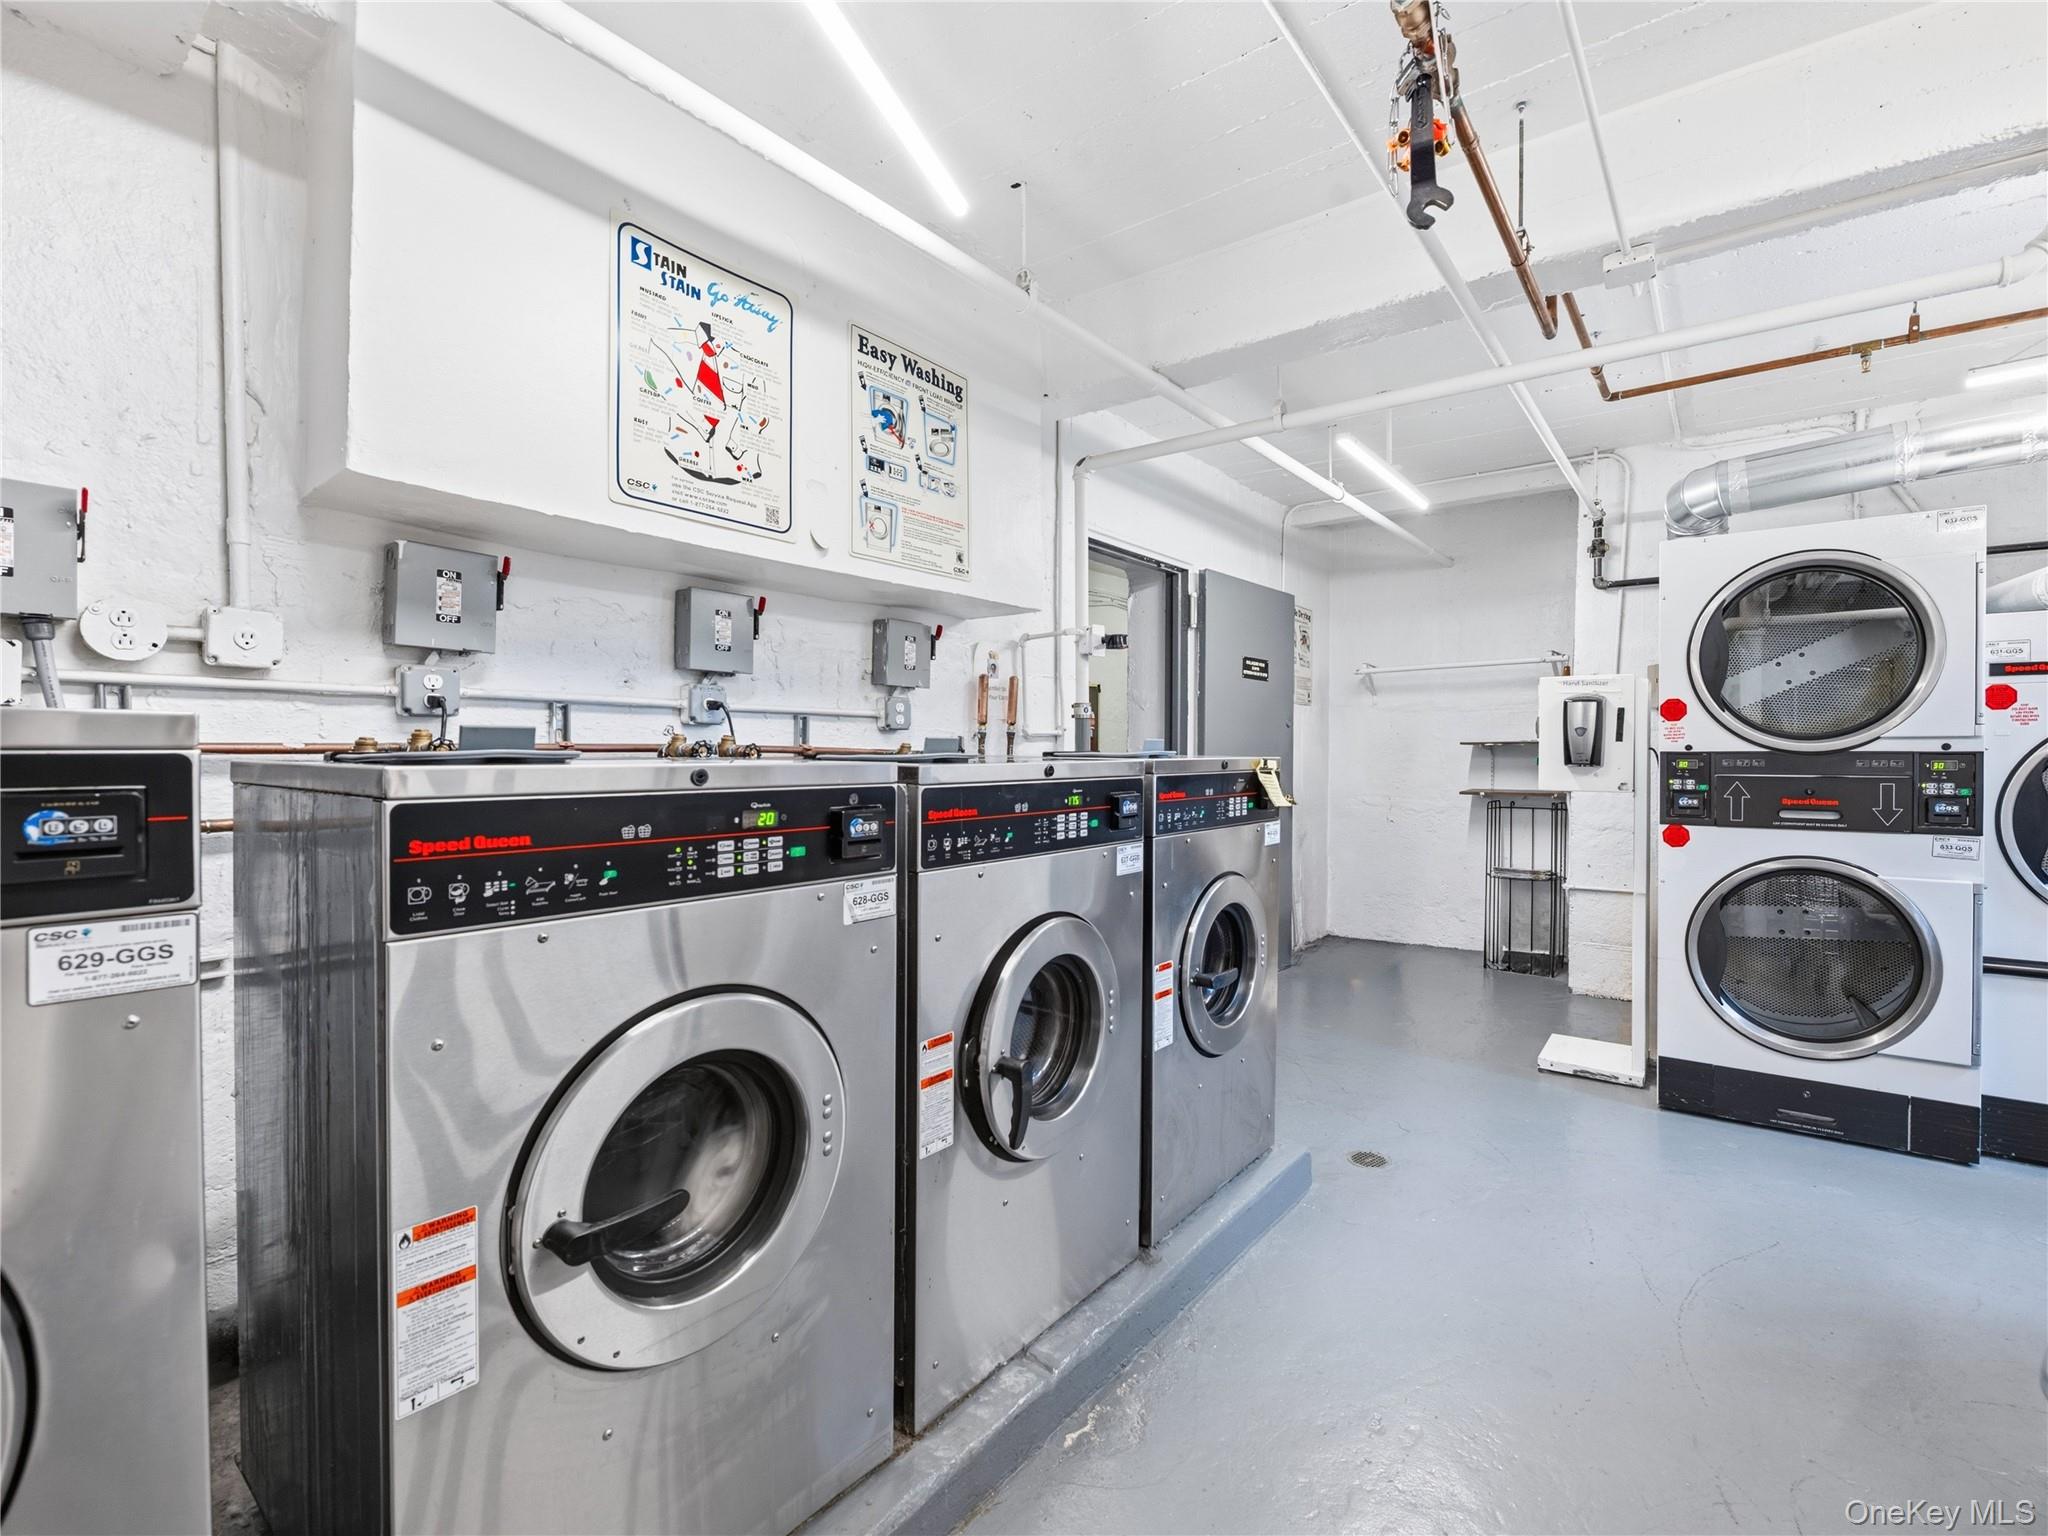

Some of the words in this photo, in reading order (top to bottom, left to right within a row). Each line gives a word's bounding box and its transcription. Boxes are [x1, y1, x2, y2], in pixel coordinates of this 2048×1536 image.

[660, 271, 701, 301] STAIN
[707, 282, 729, 307] Go
[734, 294, 781, 333] Away
[857, 334, 897, 371] Easy
[901, 353, 964, 403] Washing
[627, 478, 650, 490] CSC
[443, 570, 456, 579] ON
[440, 614, 458, 623] OFF
[718, 609, 729, 617] ON
[757, 812, 775, 826] 20
[927, 808, 953, 821] Speed
[409, 837, 471, 856] Speed
[473, 835, 532, 849] Queen
[853, 892, 889, 906] 628-GGS
[34, 930, 78, 943] CSC
[58, 944, 174, 971] 629-GGS
[428, 1210, 468, 1228] WARNING
[421, 1271, 462, 1289] WARNING
